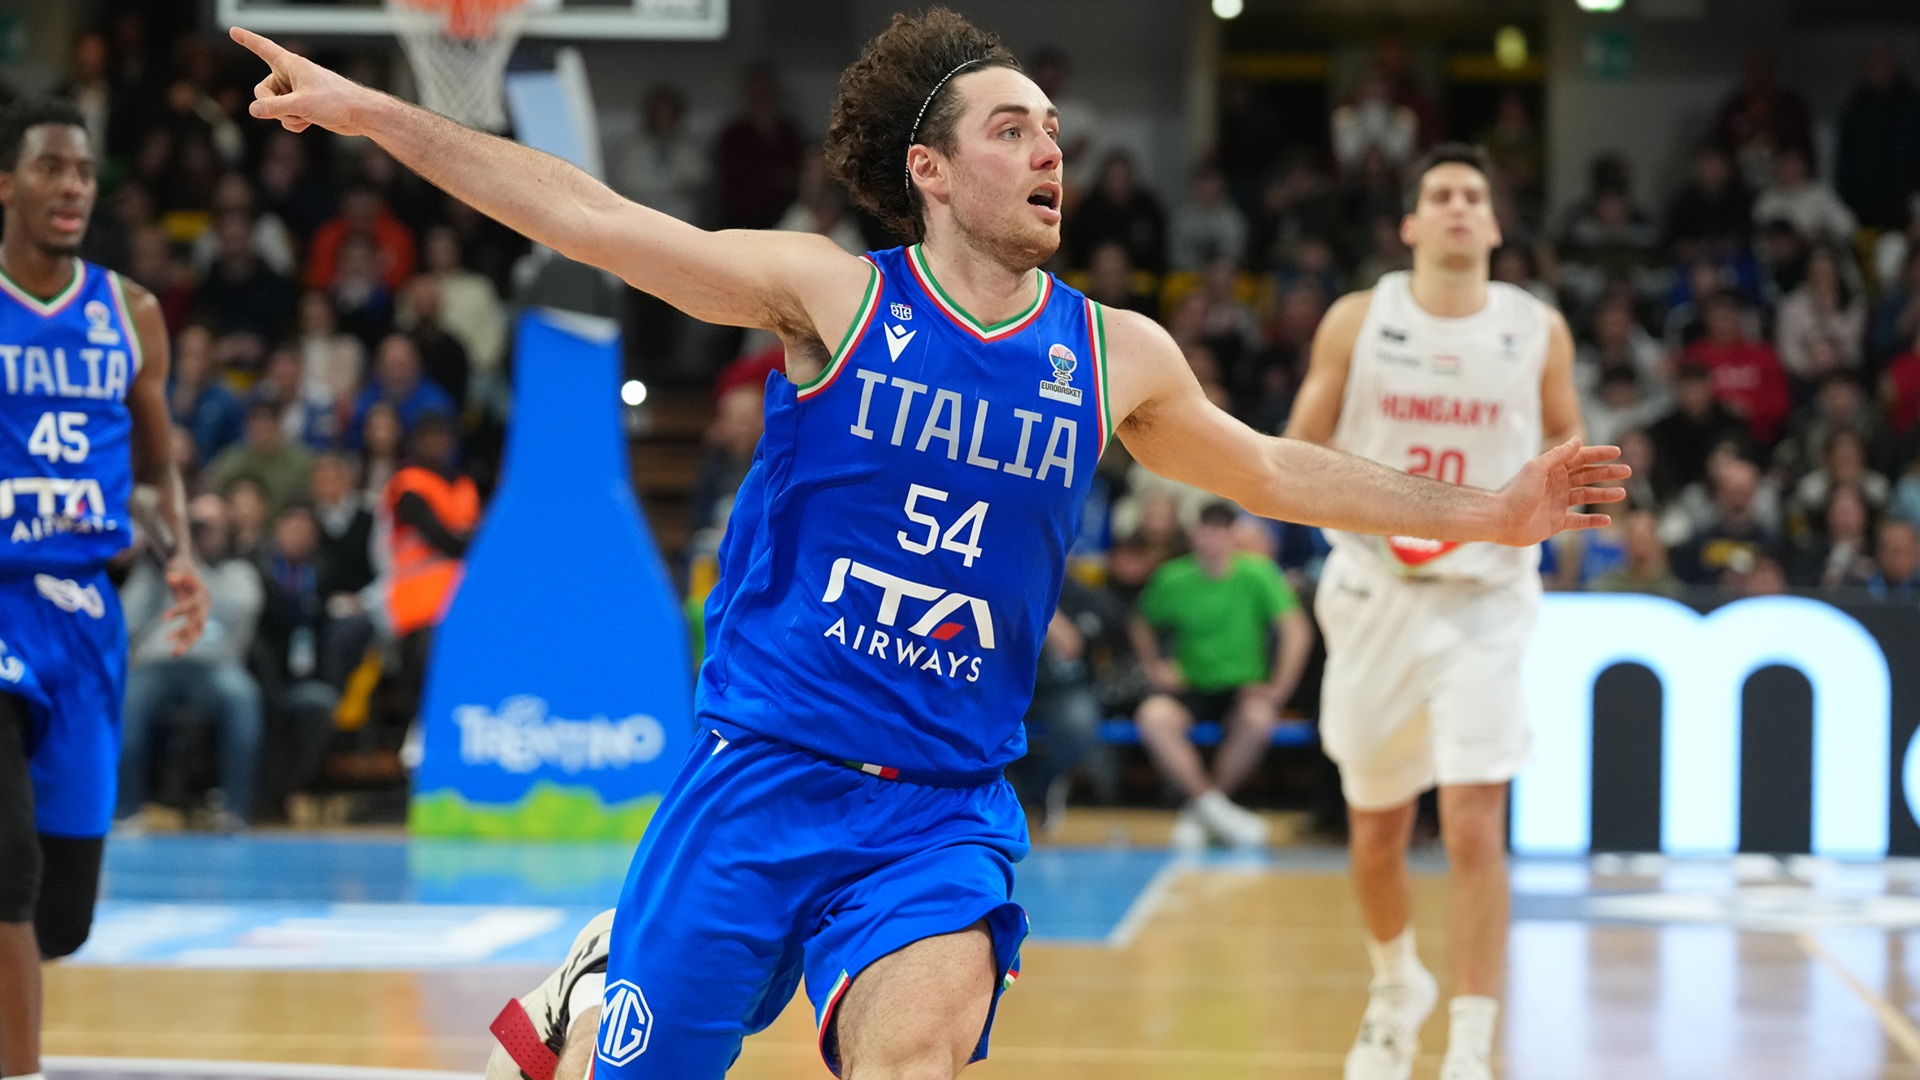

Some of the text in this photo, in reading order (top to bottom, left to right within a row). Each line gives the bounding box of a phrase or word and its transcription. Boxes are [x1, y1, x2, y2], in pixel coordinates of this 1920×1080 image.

[0, 344, 128, 402] TALIA
[1041, 381, 1082, 399] EUROBASKET
[27, 411, 91, 464] 45
[850, 368, 1078, 489] ITALIA
[1382, 393, 1502, 427] HUNGARY
[1407, 446, 1465, 487] 20
[896, 483, 990, 568] 54
[821, 557, 996, 649] ITA
[823, 616, 982, 683] AIRWAYS
[1511, 591, 1920, 863] m
[601, 986, 646, 1060] MG
